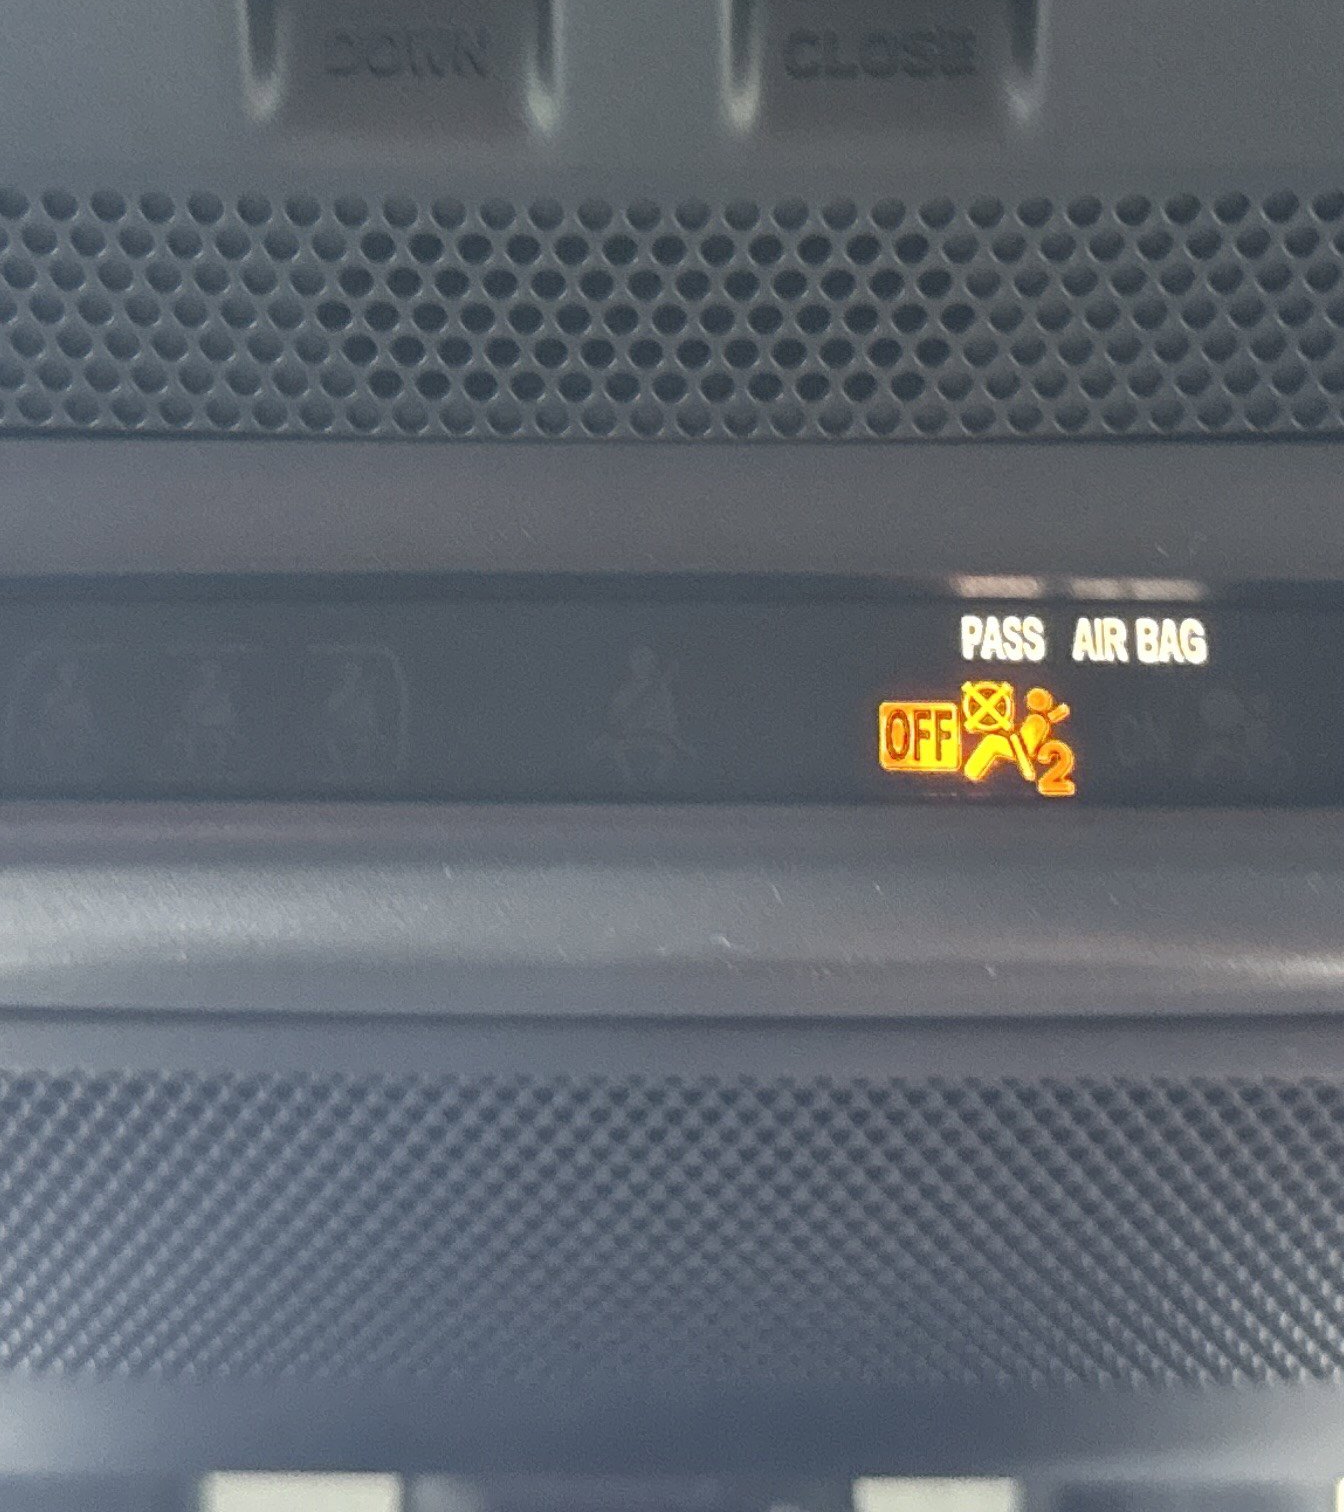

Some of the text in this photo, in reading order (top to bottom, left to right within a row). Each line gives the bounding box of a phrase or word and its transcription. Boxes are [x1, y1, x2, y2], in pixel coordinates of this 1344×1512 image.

[323, 28, 488, 80] DOWN
[784, 28, 976, 78] CLOSE
[960, 614, 1209, 664] PASS AIR BAG
[885, 709, 1076, 796] OFF 2
